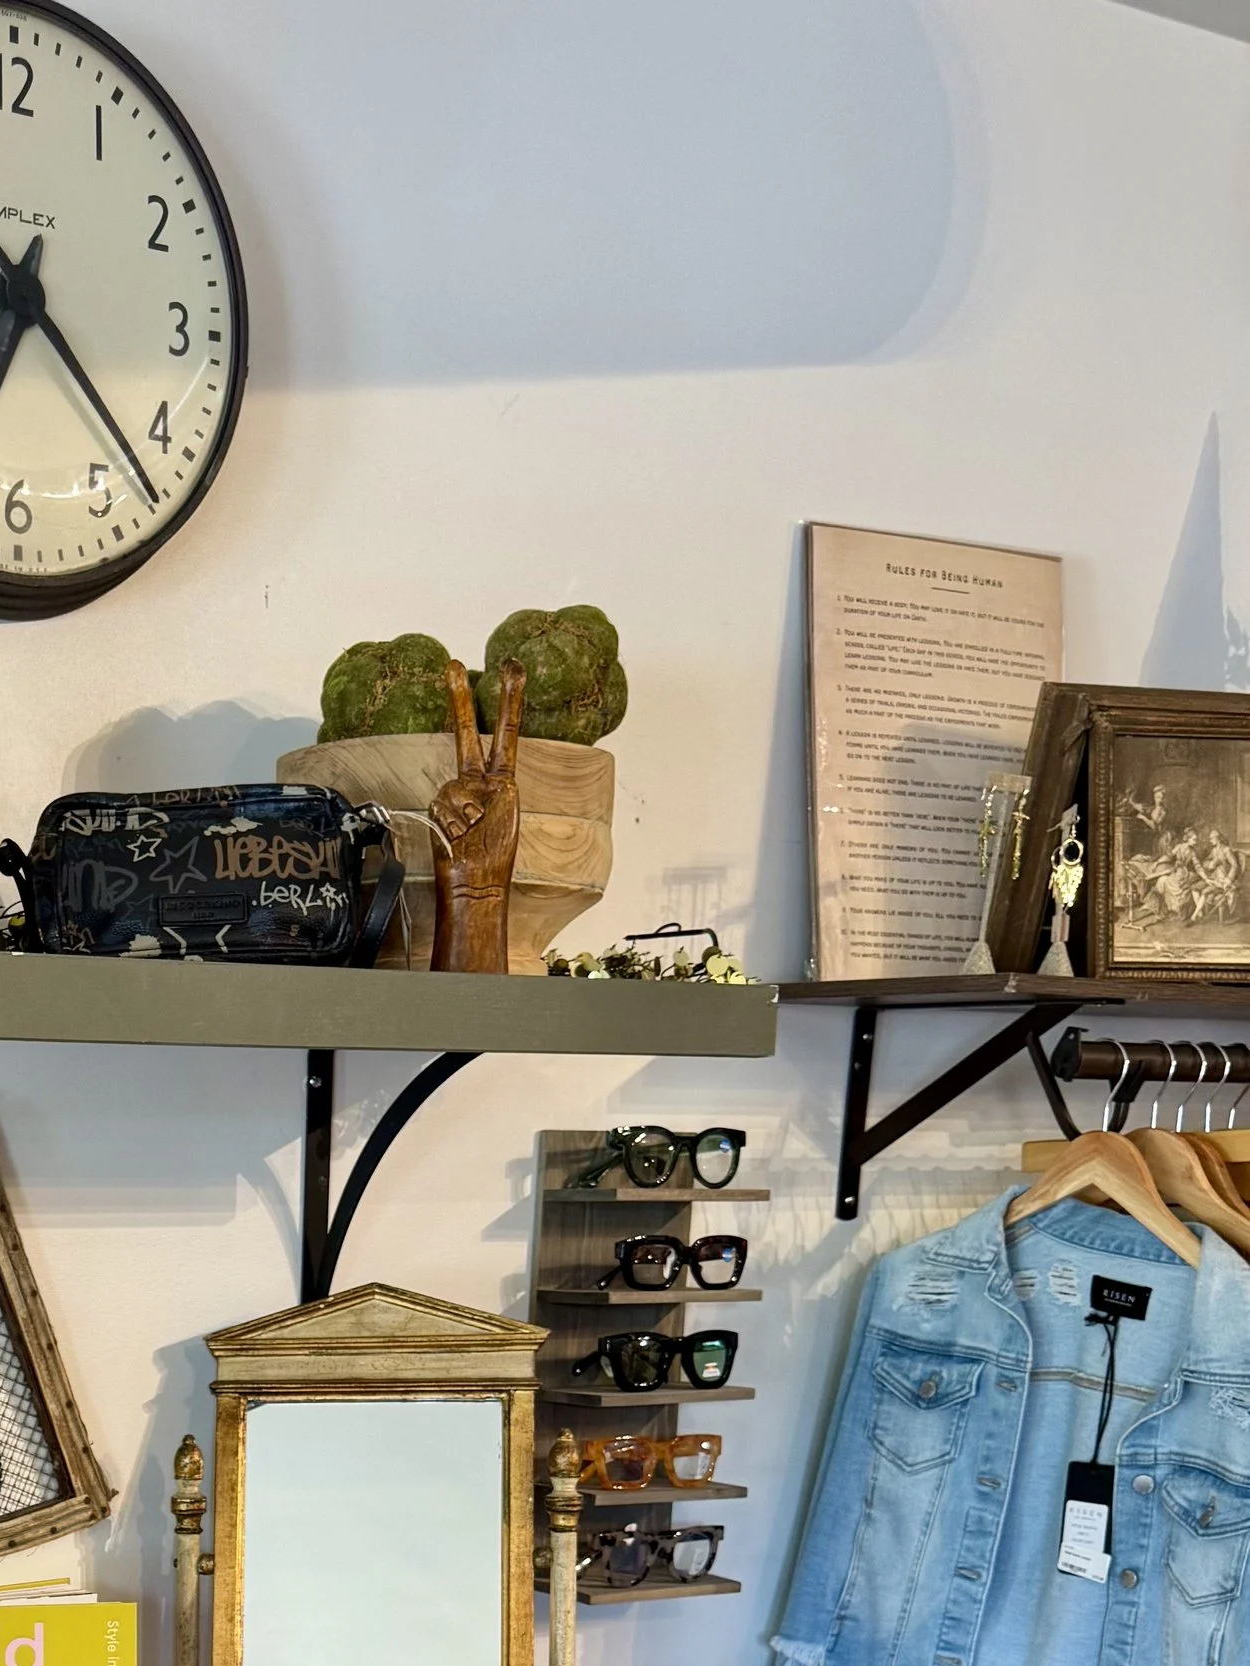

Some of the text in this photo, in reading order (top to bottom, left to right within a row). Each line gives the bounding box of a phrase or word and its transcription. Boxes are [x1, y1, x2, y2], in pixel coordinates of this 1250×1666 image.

[95, 104, 103, 161] 1
[147, 194, 169, 253] 2
[168, 301, 190, 357] 3
[148, 400, 172, 454] 4
[4, 479, 33, 534] 6
[87, 462, 110, 518] 5
[106, 1620, 120, 1654] Style
